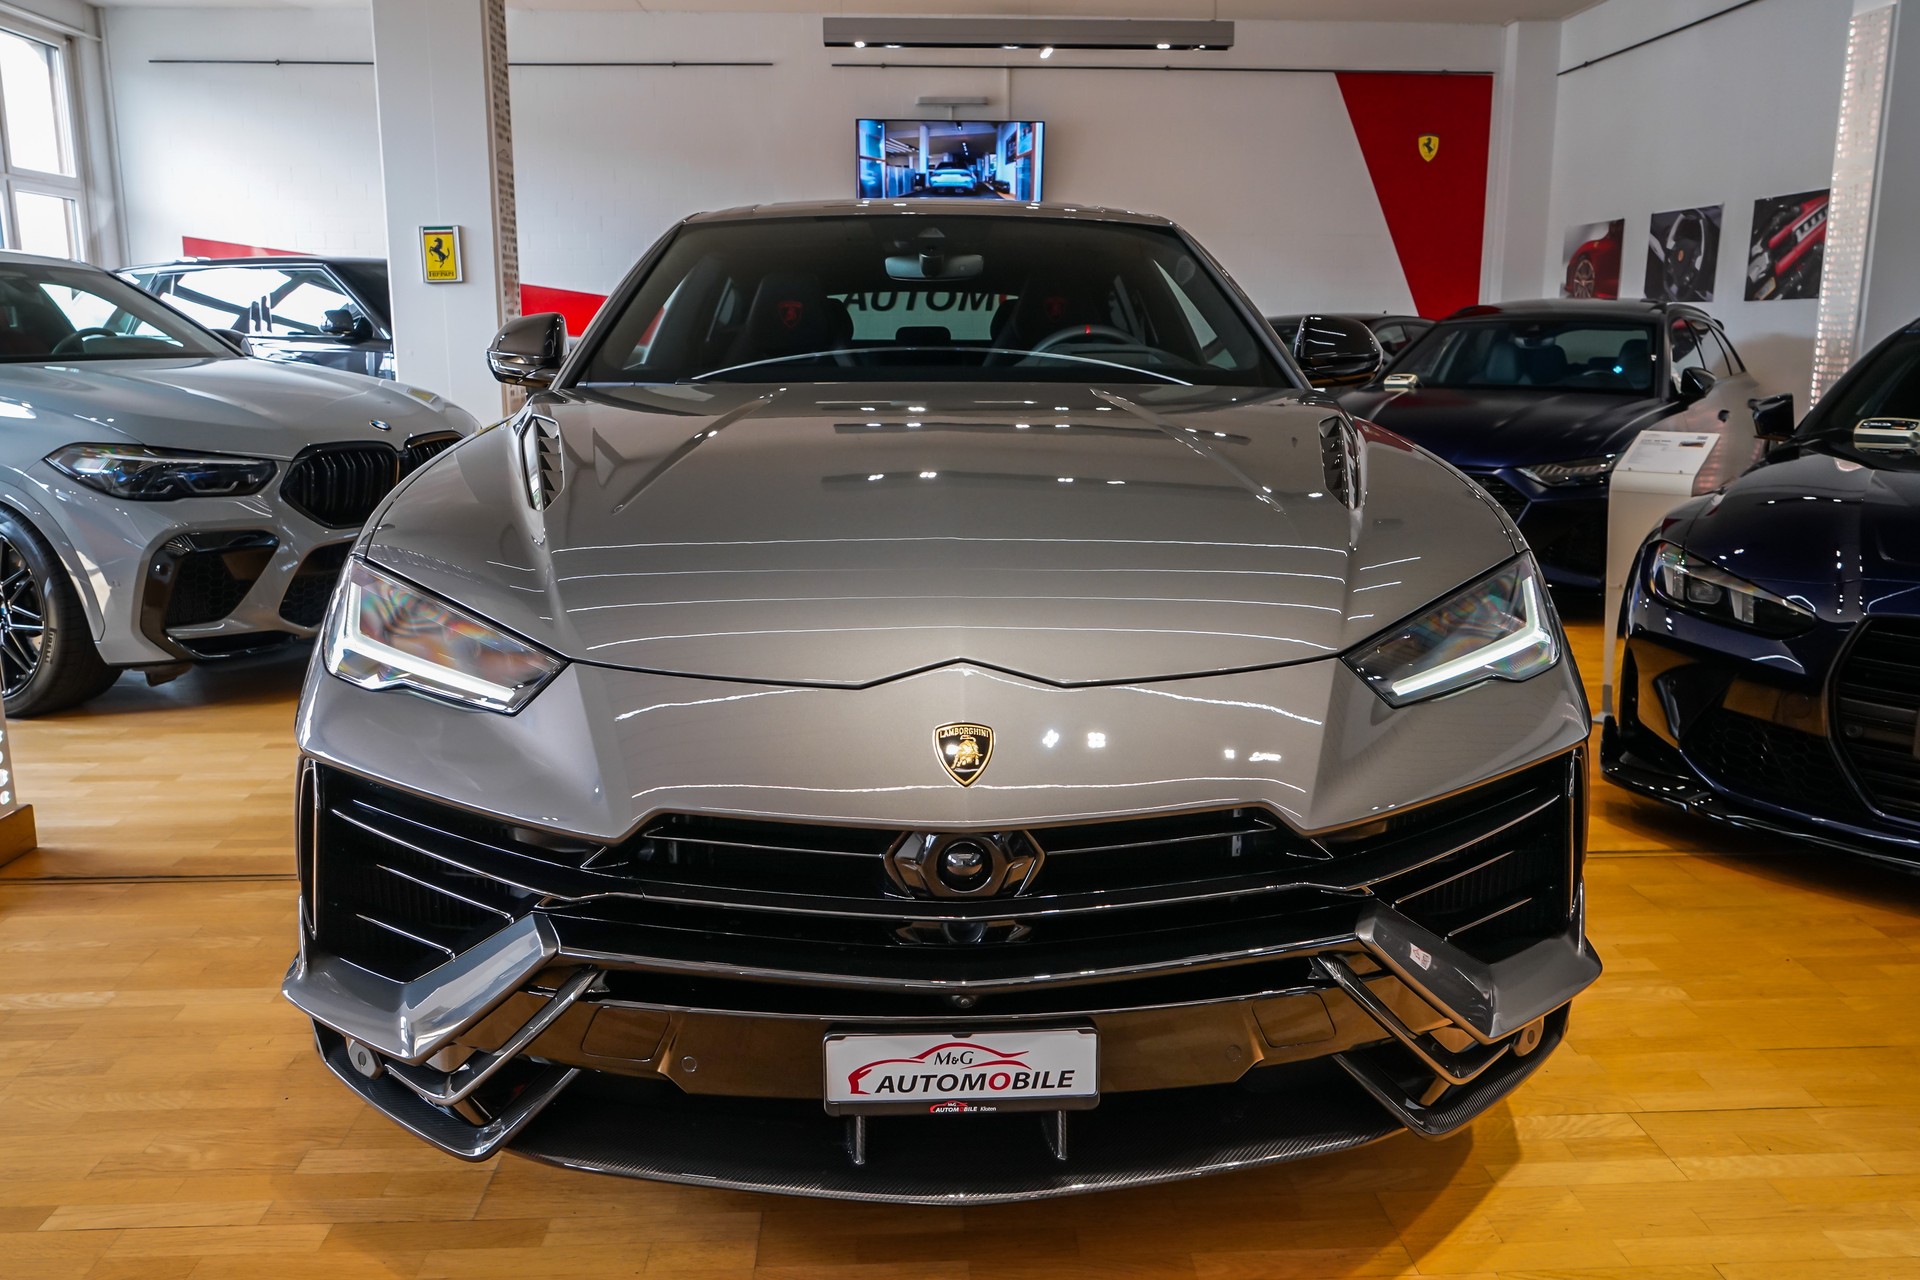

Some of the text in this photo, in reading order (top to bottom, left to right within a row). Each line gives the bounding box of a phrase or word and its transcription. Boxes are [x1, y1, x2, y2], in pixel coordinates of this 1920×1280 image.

[940, 727, 989, 738] LAMBORGHINI
[934, 1051, 974, 1066] M&G
[875, 1069, 1075, 1094] AUTOMOBILE
